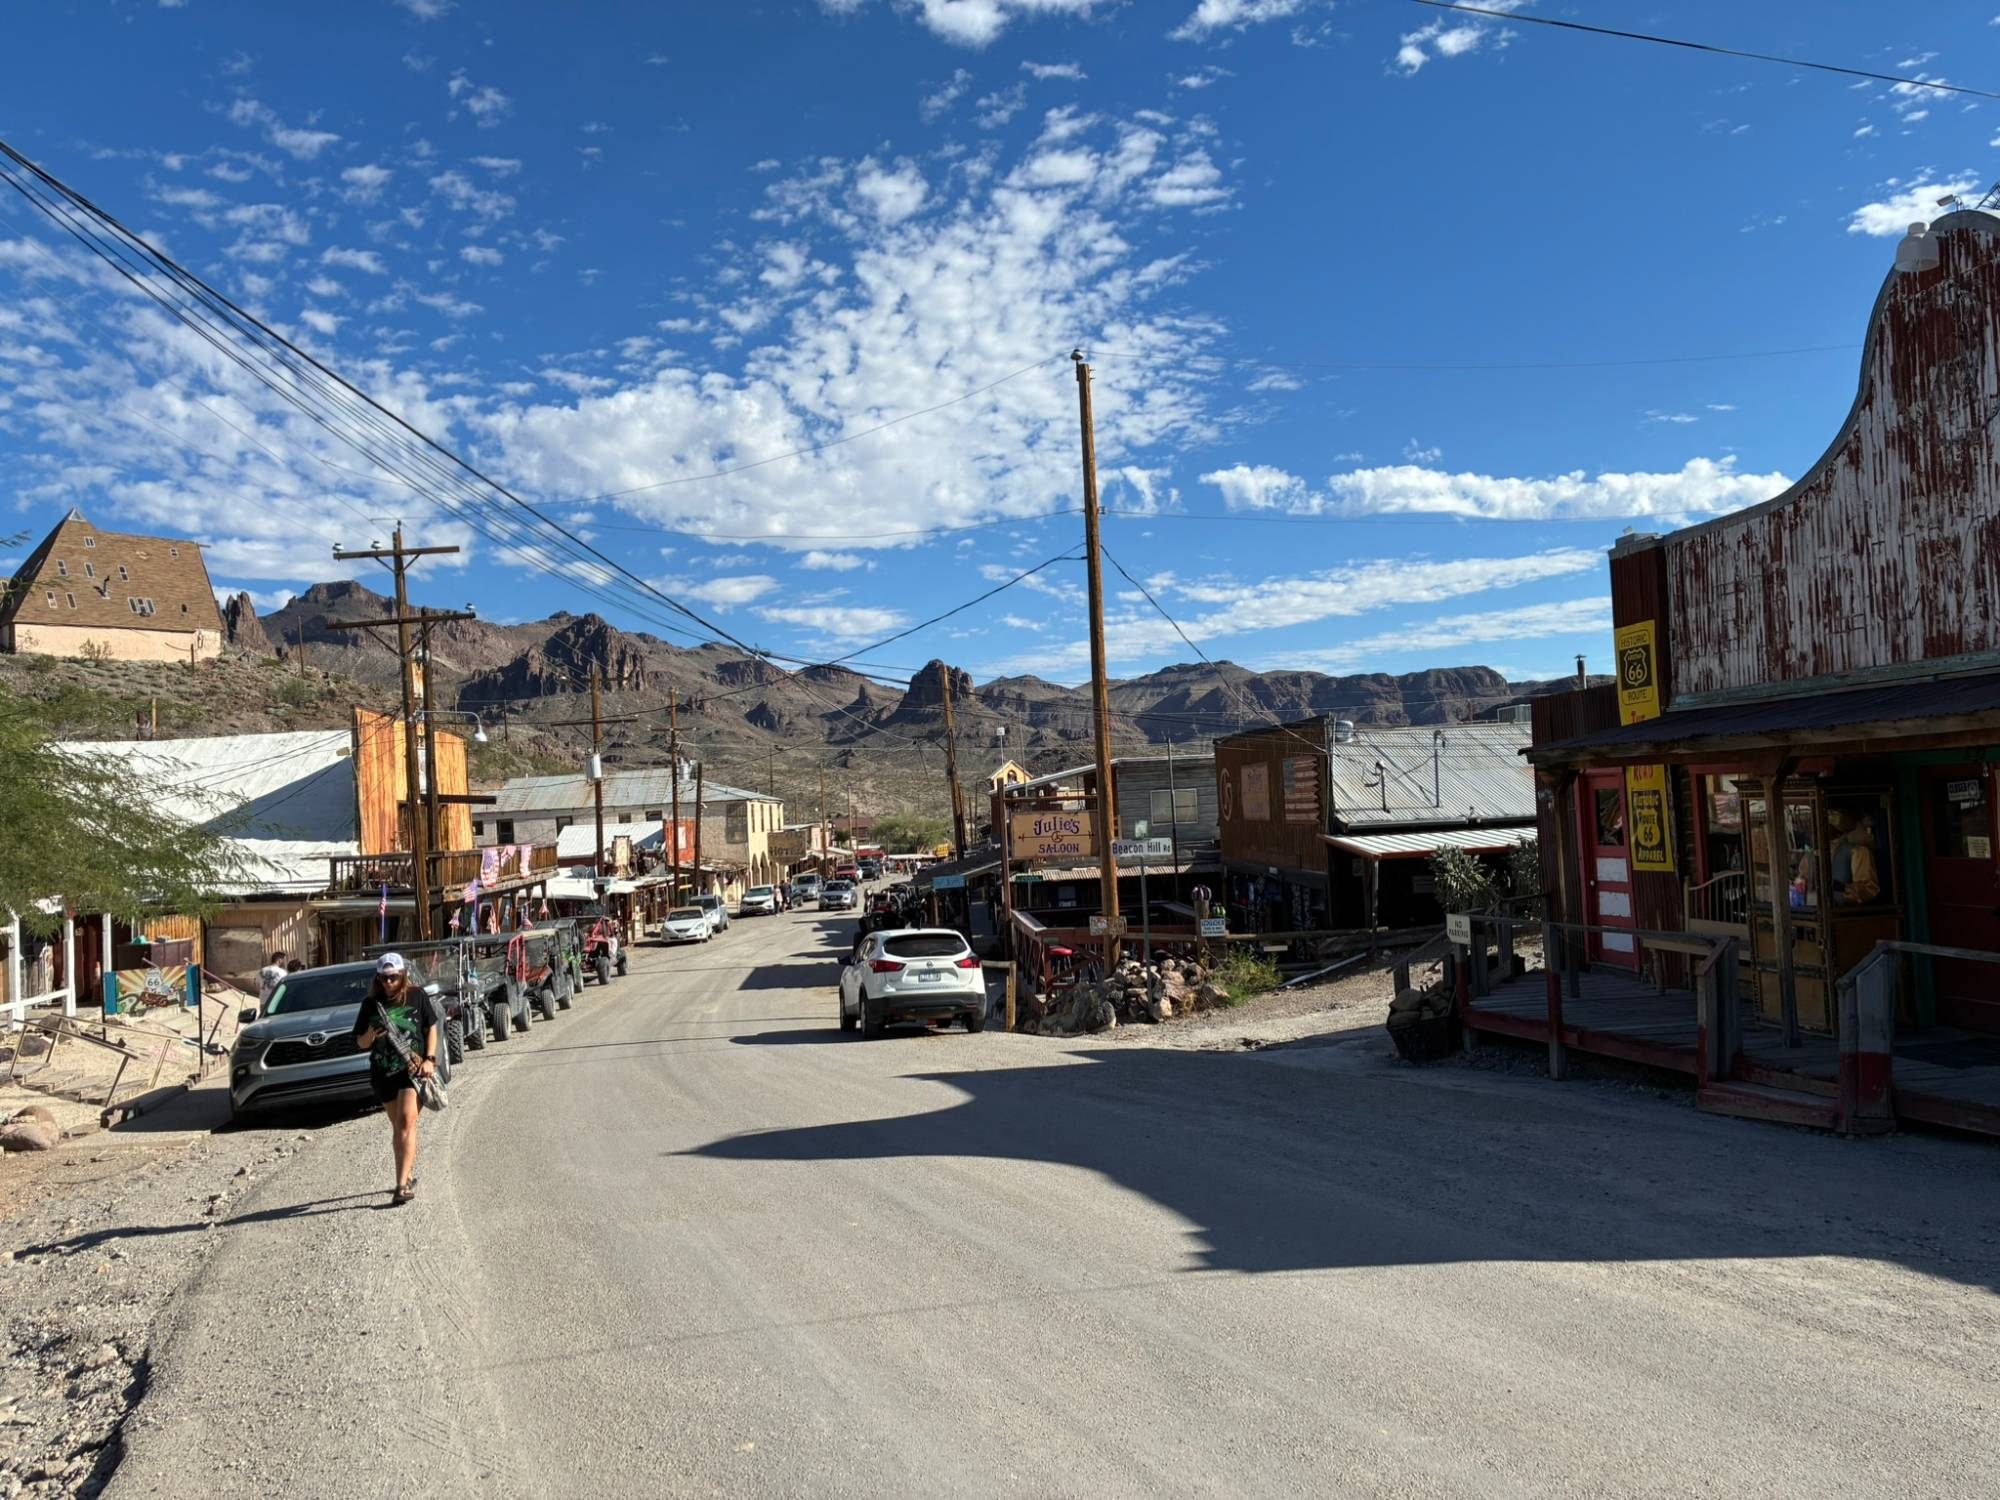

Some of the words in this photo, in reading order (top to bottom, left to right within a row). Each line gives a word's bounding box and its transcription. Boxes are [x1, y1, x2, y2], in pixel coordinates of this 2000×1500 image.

[1621, 632, 1647, 648] HISTORIC
[1628, 664, 1643, 681] 66
[1627, 689, 1647, 703] ROUTE
[1639, 814, 1657, 825] ROUTE
[1643, 826, 1653, 842] 66
[1038, 843, 1080, 854] SALOON
[1112, 842, 1144, 855] Beacon
[1147, 840, 1161, 853] Hill
[1638, 849, 1664, 861] APPAREL
[1454, 920, 1462, 928] NO
[147, 978, 160, 986] 66
